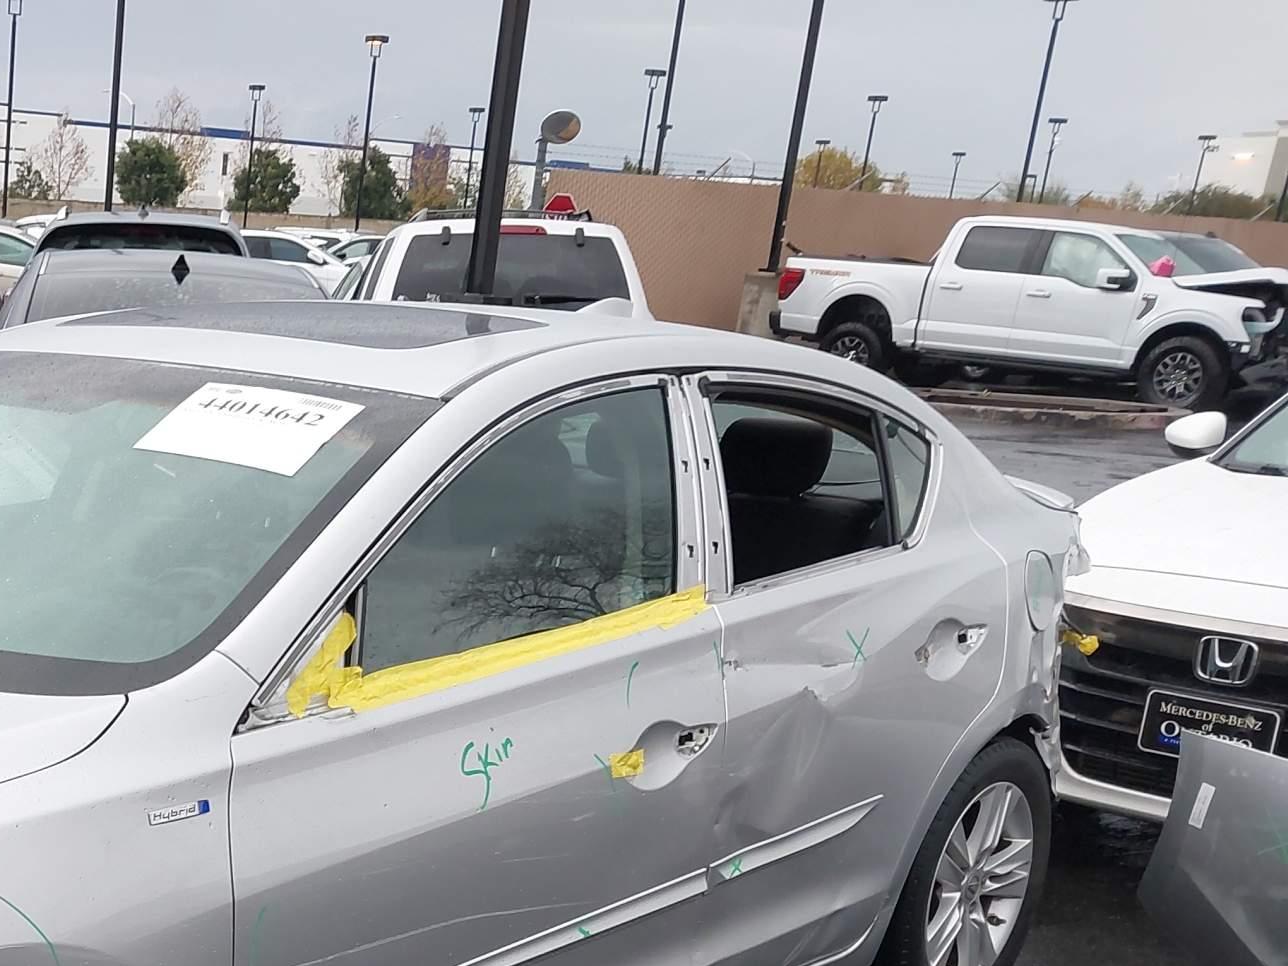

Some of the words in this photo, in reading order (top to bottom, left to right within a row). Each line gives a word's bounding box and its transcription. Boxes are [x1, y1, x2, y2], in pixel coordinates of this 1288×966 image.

[198, 398, 325, 426] 44014642
[1159, 701, 1264, 732] MERCEDES-BENZ
[1201, 720, 1214, 733] of
[152, 803, 196, 821] Hybrid
